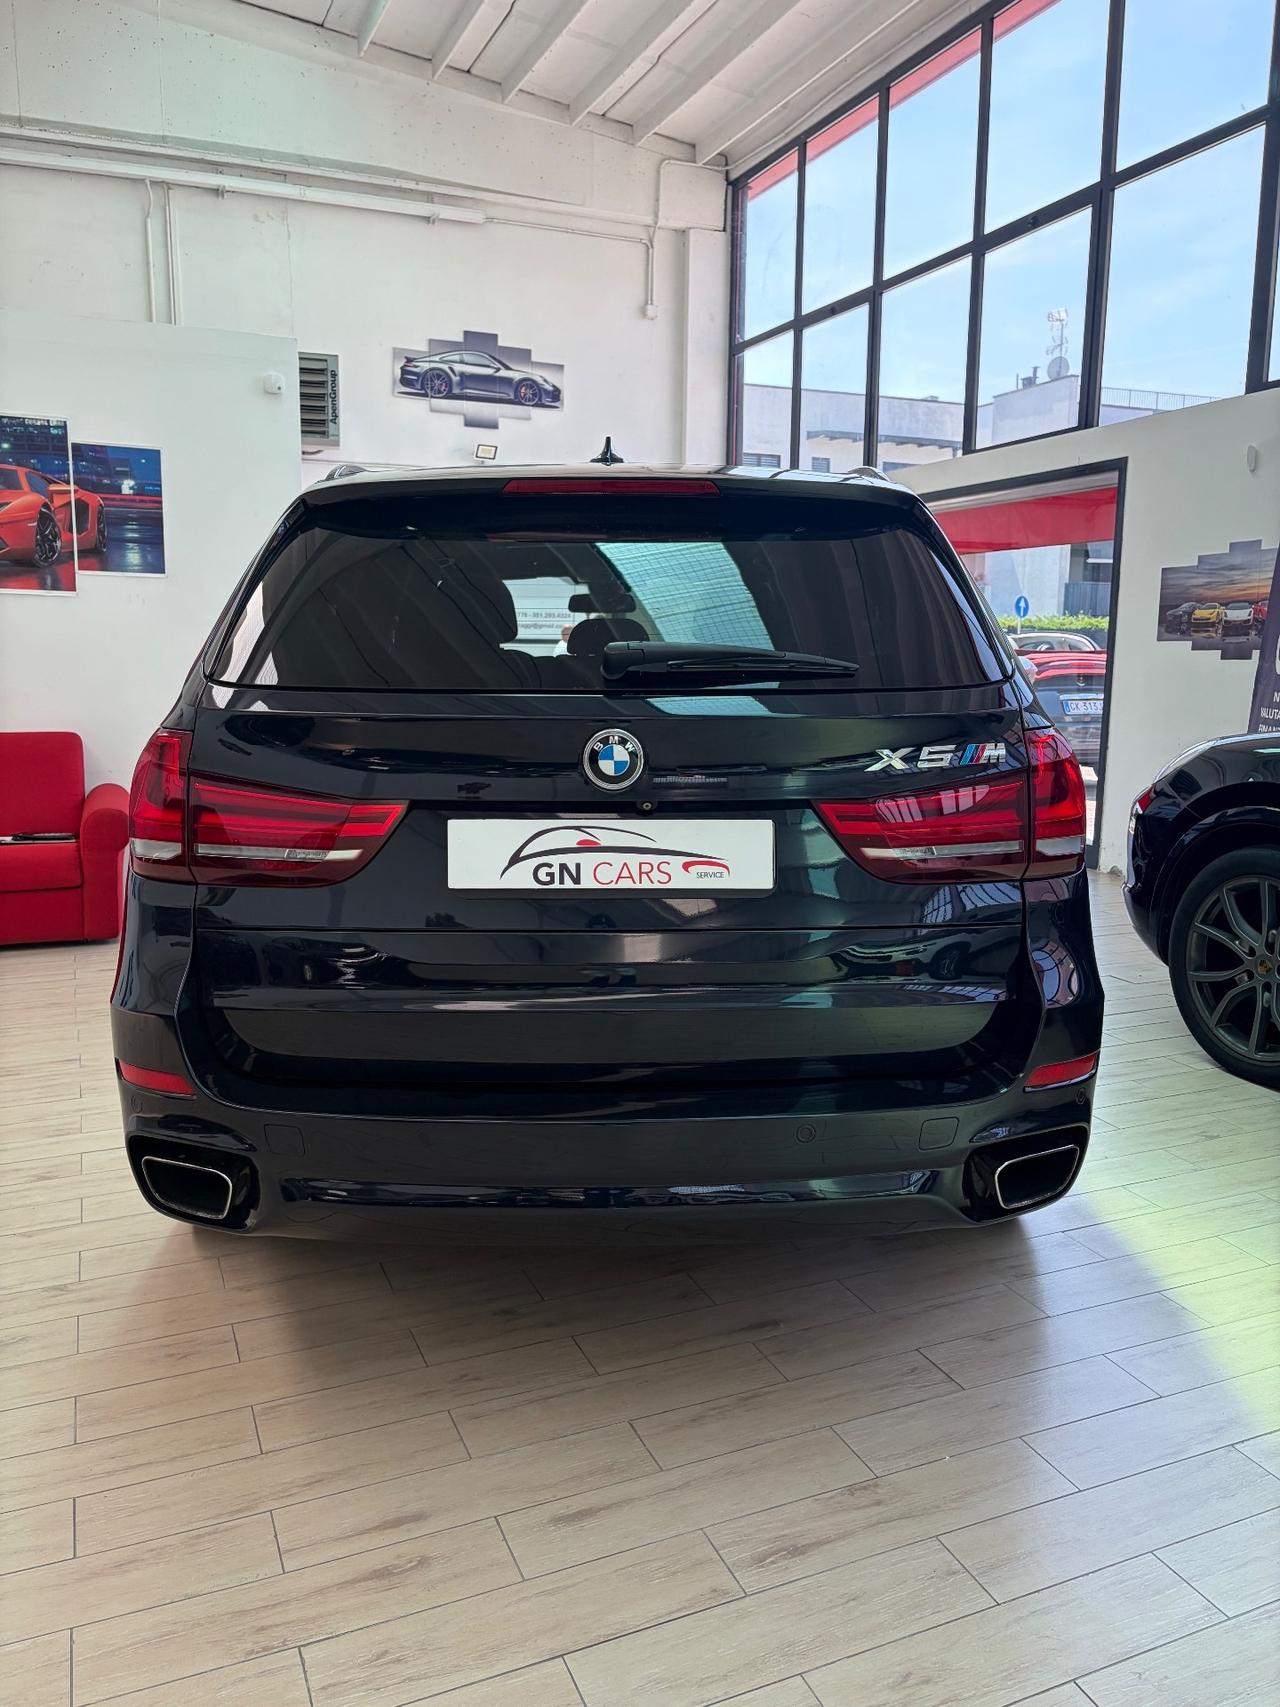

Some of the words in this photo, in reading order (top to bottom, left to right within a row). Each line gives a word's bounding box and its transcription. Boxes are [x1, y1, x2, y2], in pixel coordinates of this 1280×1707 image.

[329, 369, 339, 425] ApenGroup
[593, 735, 636, 753] BMW
[532, 862, 582, 886] GN
[592, 860, 672, 886] CARS
[696, 871, 725, 879] SERVICE
